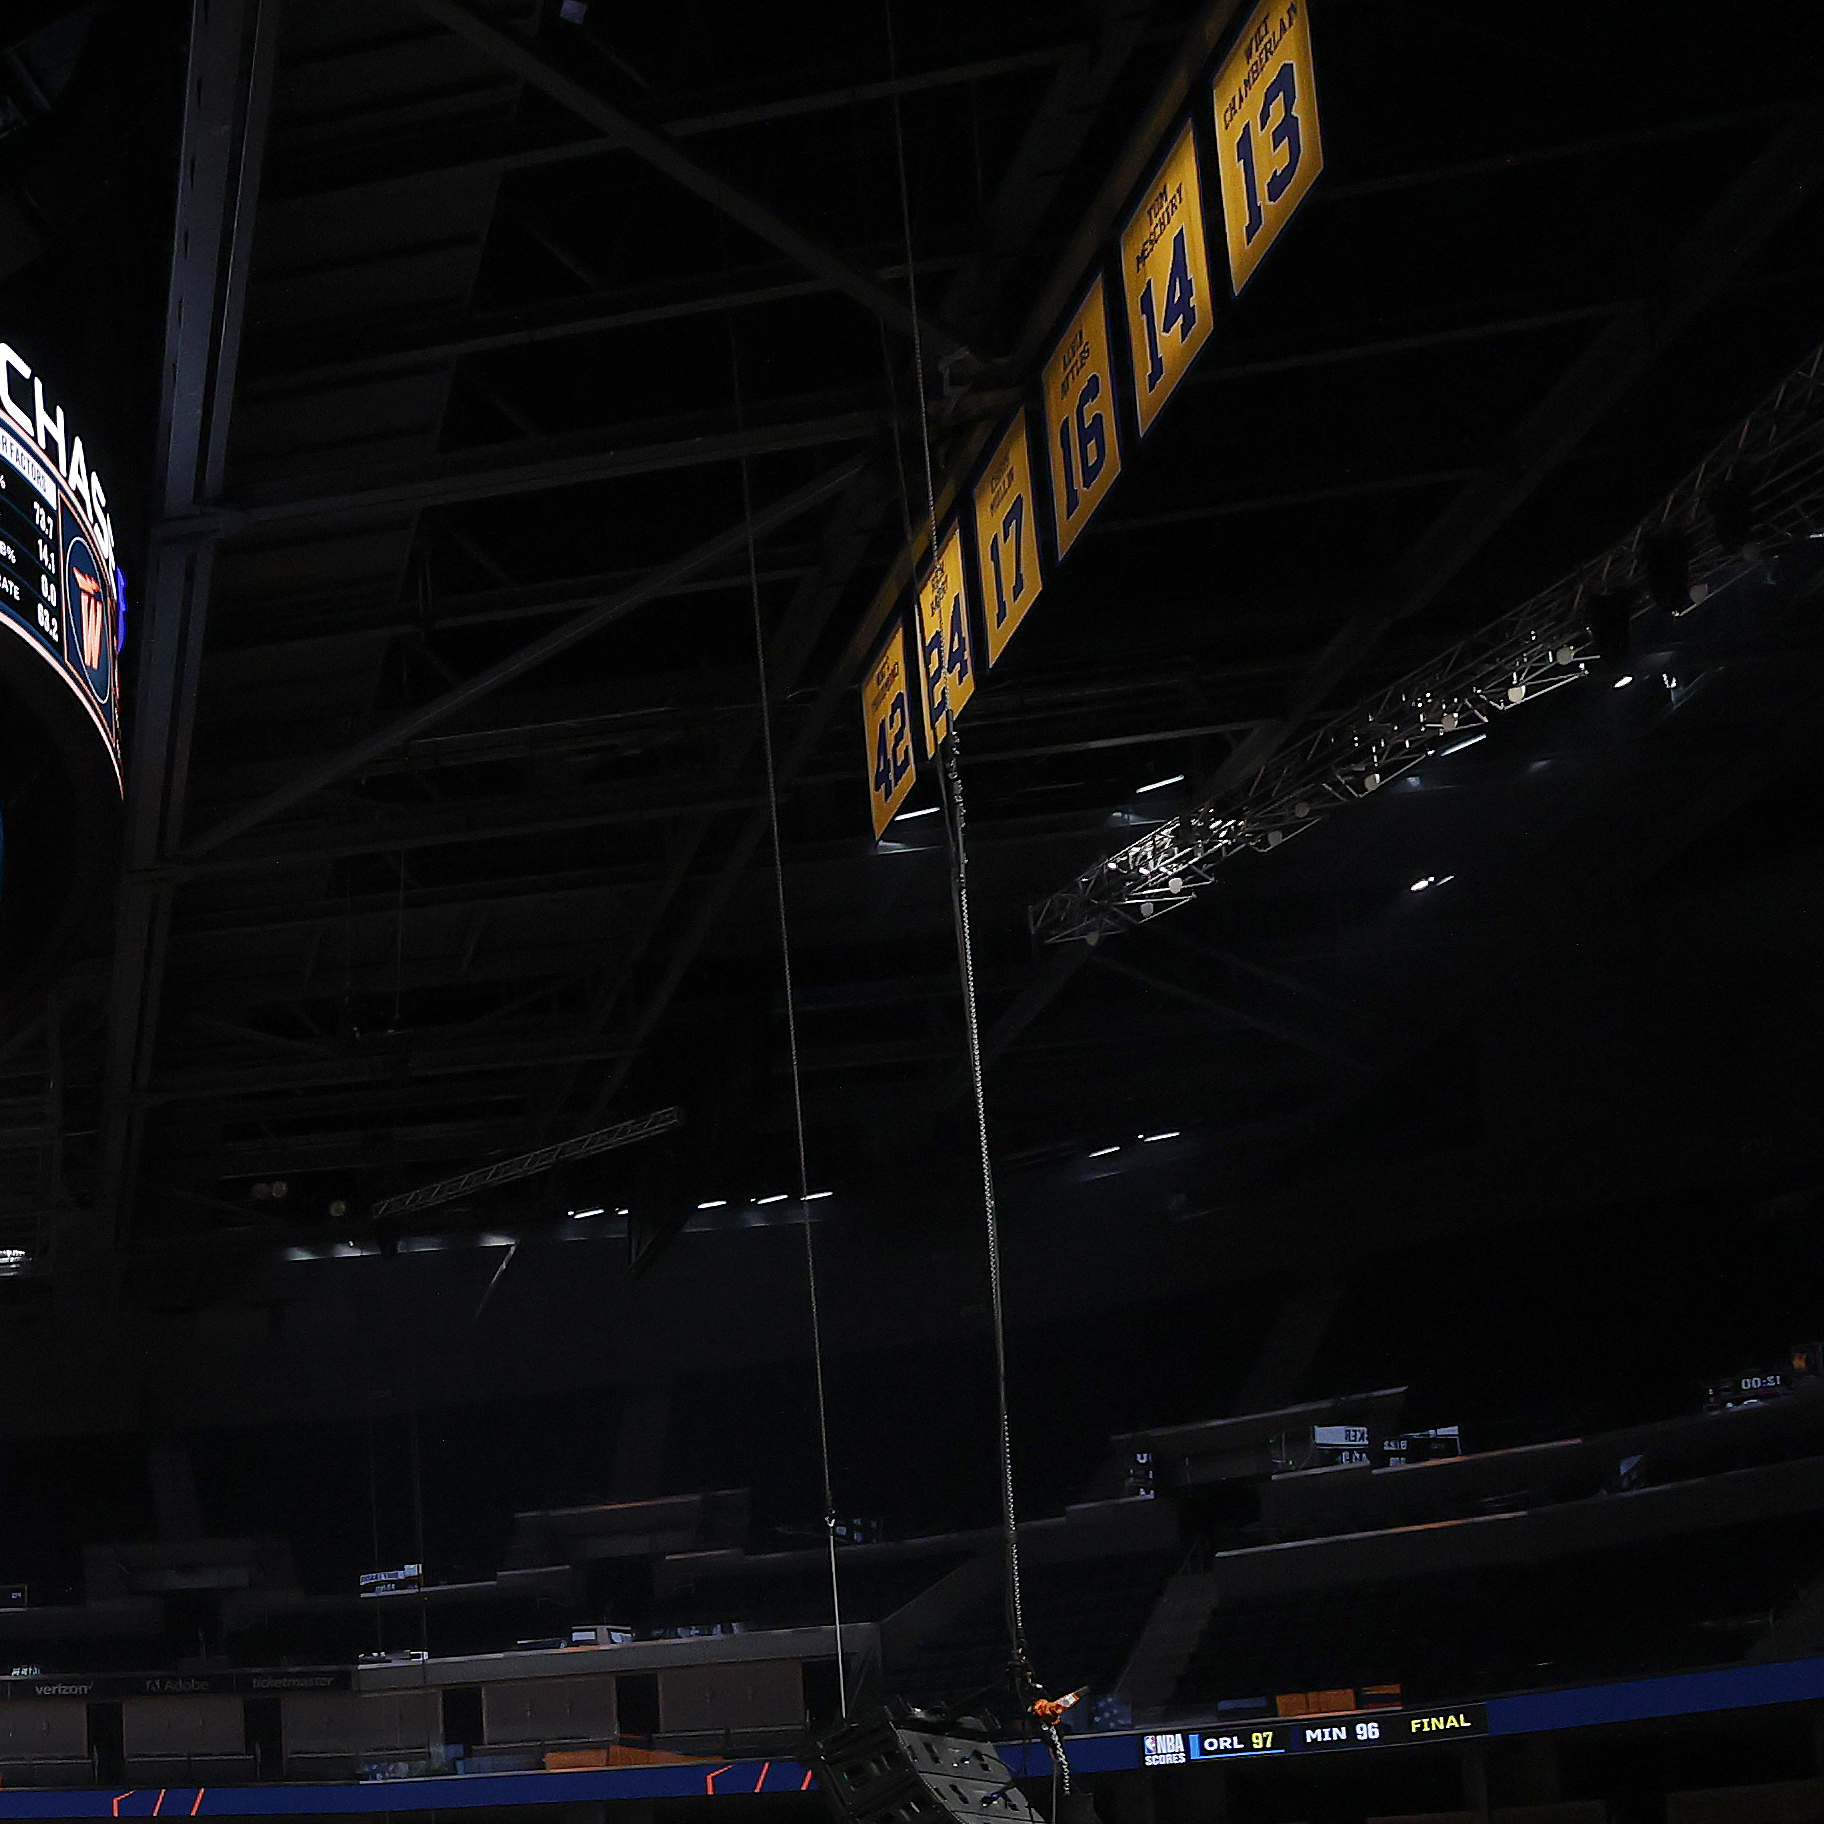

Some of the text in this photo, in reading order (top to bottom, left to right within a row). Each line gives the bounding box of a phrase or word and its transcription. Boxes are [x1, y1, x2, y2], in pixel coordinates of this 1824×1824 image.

[1236, 60, 1302, 248] 13
[1139, 224, 1196, 394] 14
[1060, 372, 1105, 521] 16
[990, 493, 1024, 629] 17
[925, 593, 968, 723] 24
[875, 692, 910, 802] 42
[1145, 1753, 1186, 1766] SCORES
[1156, 1734, 1184, 1752] NBA
[1204, 1714, 1471, 1751] ORL 97 MIN 96 FINAL
